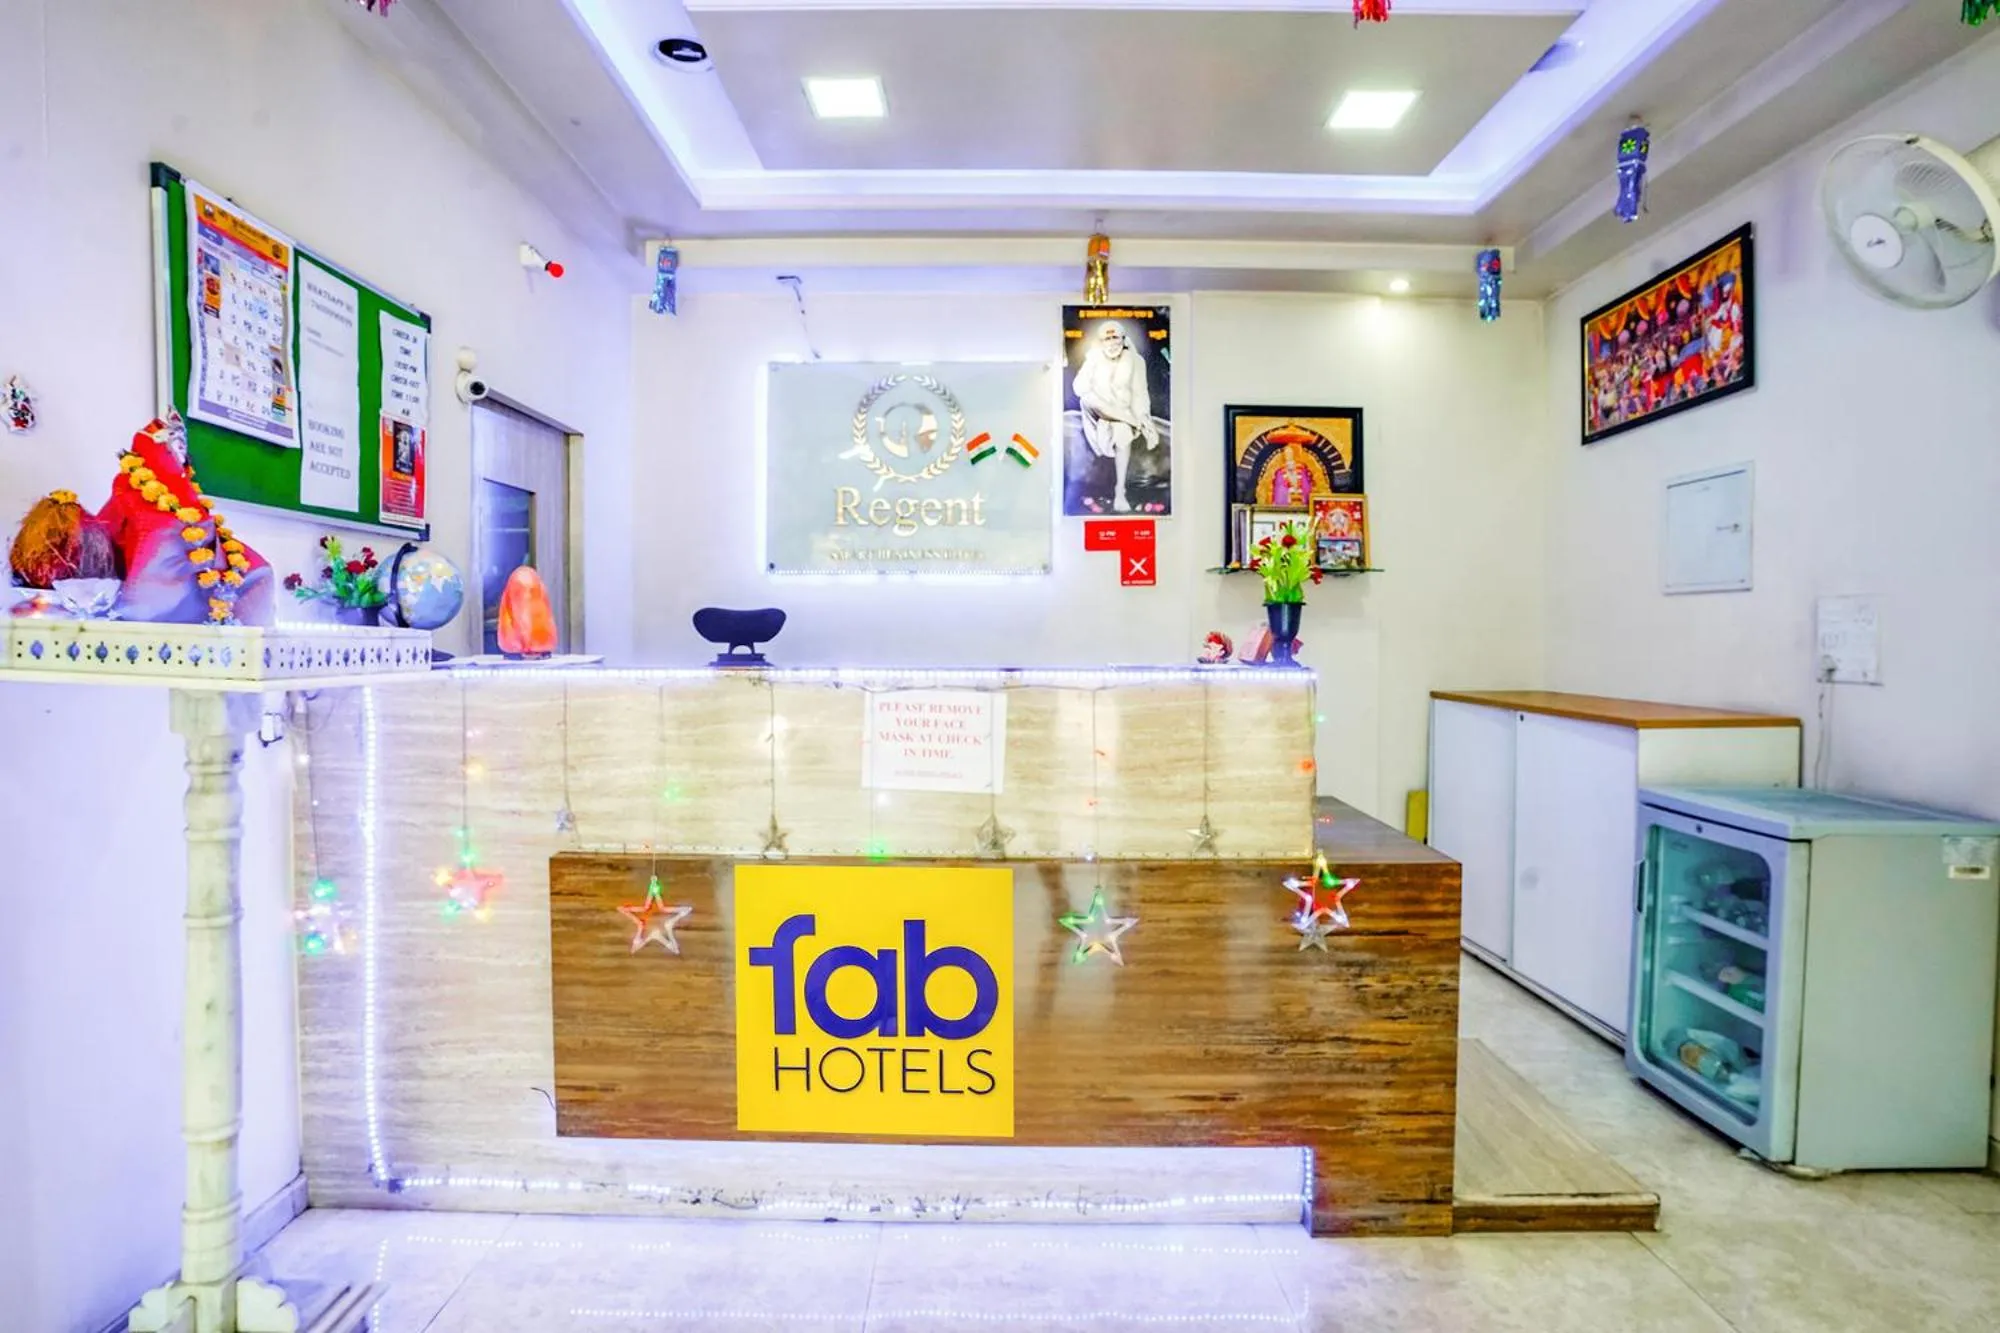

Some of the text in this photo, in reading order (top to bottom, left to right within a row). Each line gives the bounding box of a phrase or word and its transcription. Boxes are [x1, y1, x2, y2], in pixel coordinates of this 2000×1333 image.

[834, 486, 988, 537] Regent
[878, 702, 982, 715] PLEASE REMOVE
[895, 717, 965, 729] YOUR FACE
[879, 731, 982, 746] MASK AT CHECK
[904, 748, 916, 757] IN
[749, 914, 999, 1040] fab
[774, 1046, 997, 1095] HOTELS
